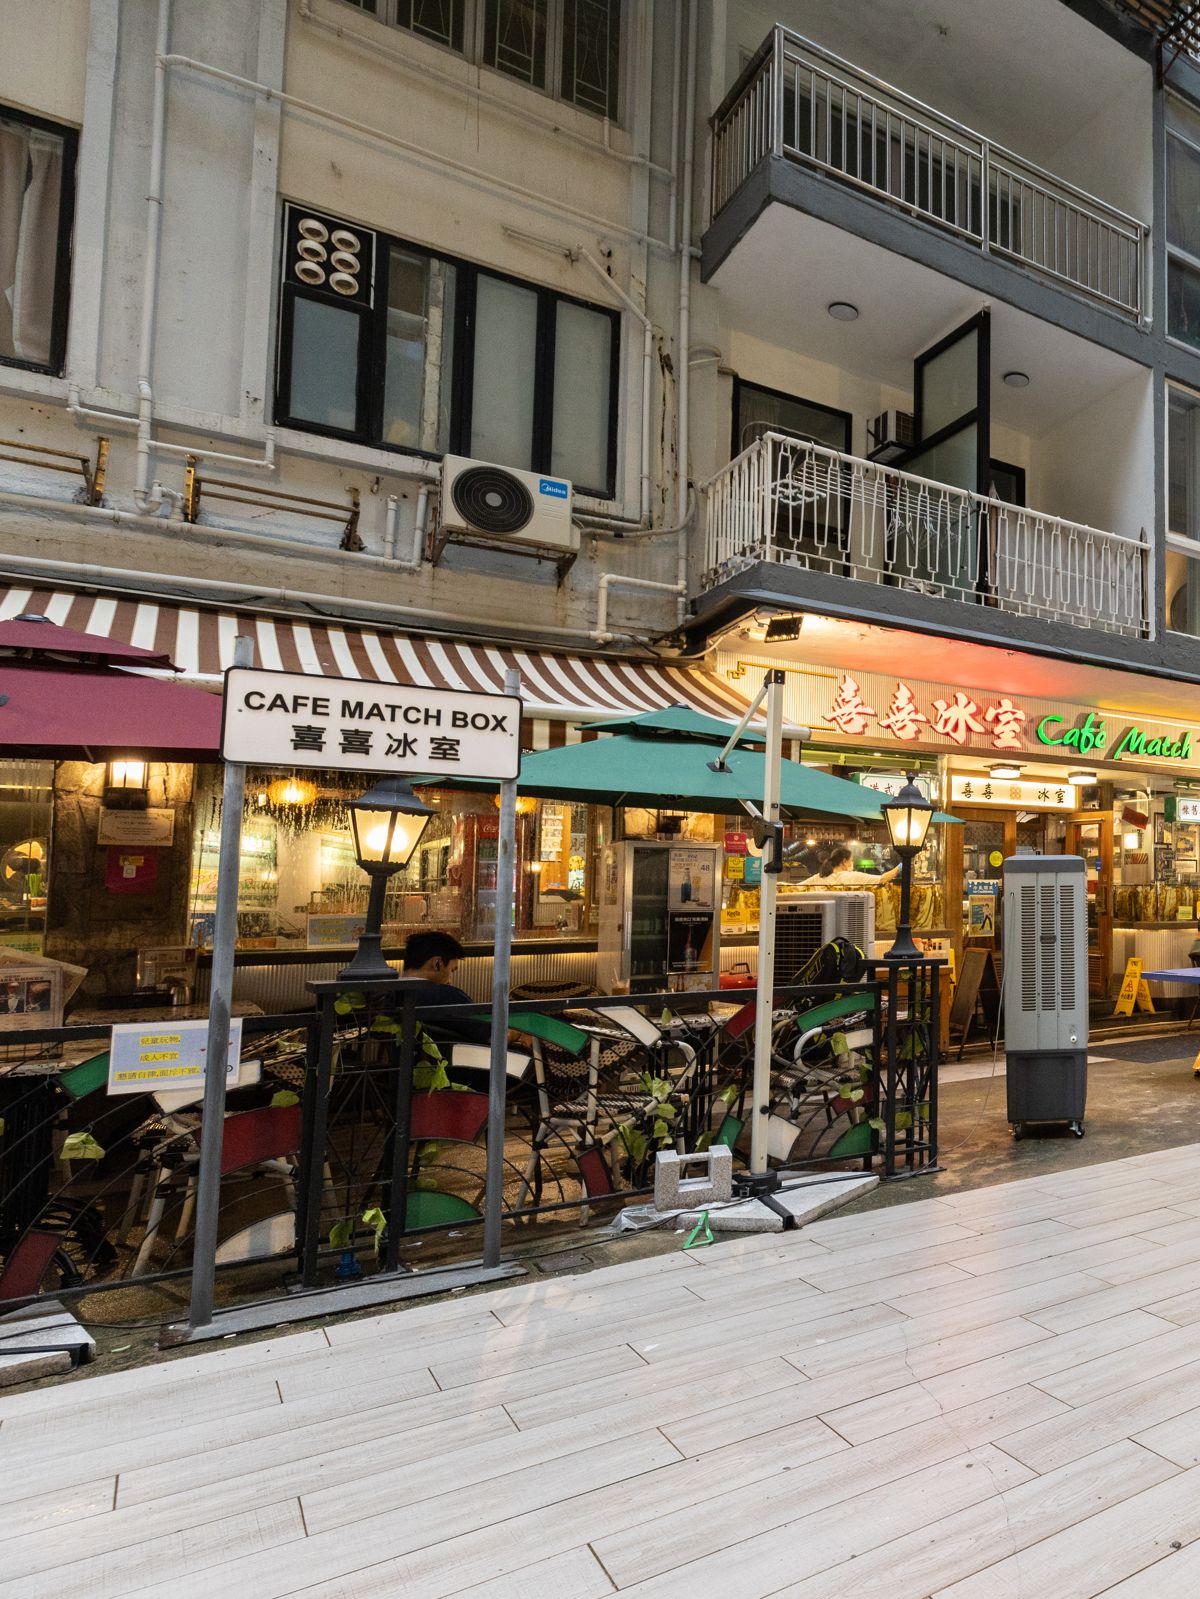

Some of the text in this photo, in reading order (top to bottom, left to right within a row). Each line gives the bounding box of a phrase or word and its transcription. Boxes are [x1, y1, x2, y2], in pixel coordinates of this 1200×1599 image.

[244, 690, 508, 733] CAFE MATCH BOX
[824, 674, 1026, 749] 喜喜冰室
[290, 725, 461, 762] 喜喜冰室
[1036, 712, 1107, 754] Café
[1115, 726, 1193, 760] Match
[961, 781, 1067, 804] 喜喜 冰室
[140, 1053, 178, 1061] 成人不宜
